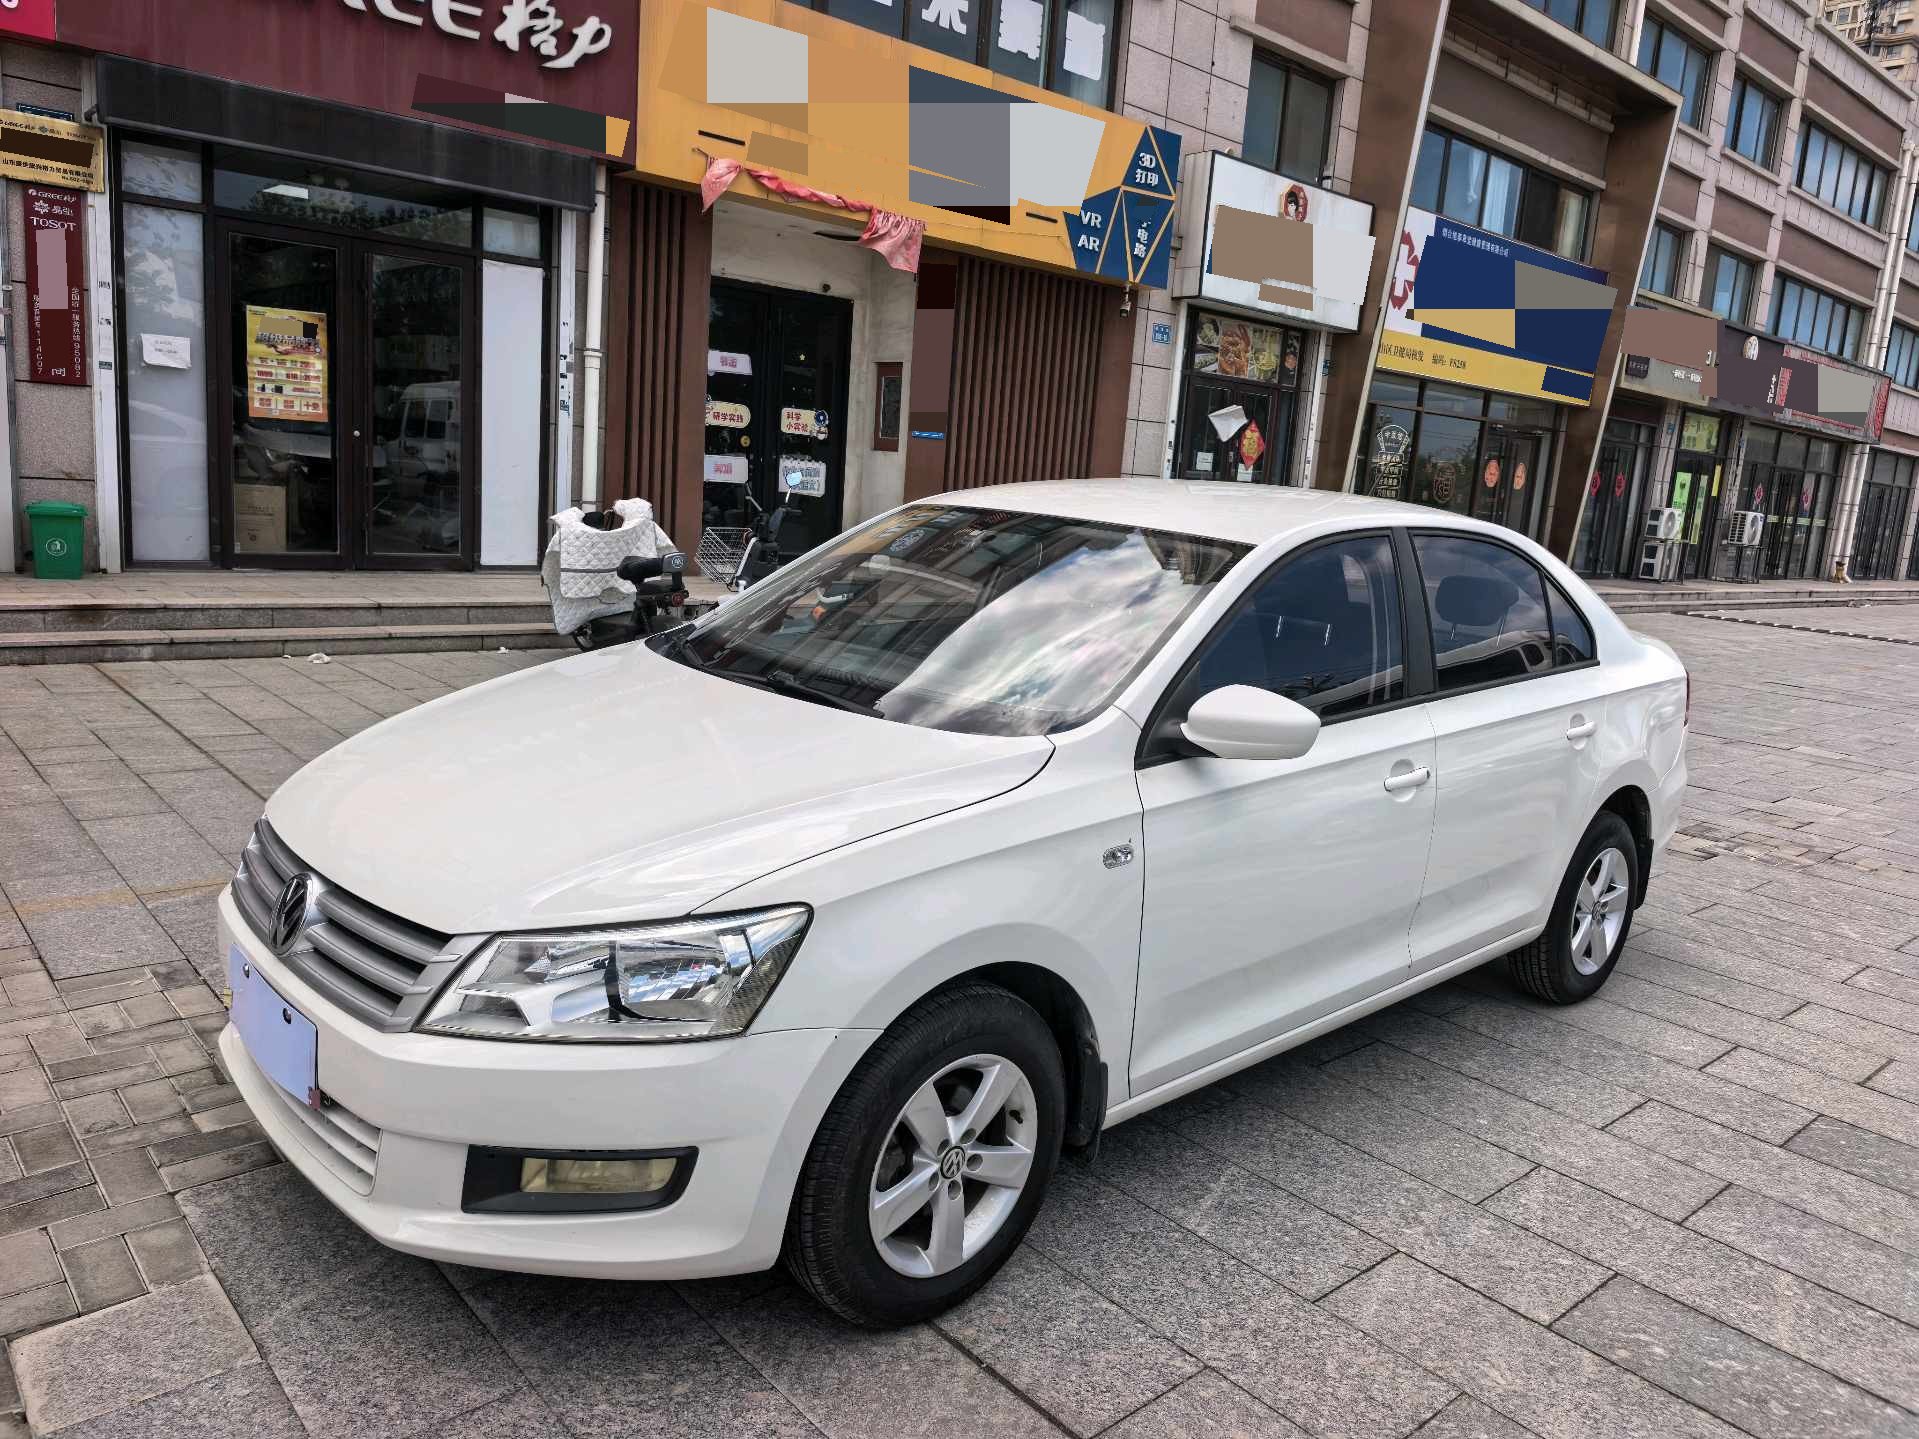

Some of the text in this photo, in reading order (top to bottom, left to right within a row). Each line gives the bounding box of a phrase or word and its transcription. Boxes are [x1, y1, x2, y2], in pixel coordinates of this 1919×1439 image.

[1138, 152, 1156, 168] 3D
[1135, 168, 1159, 187] 打印
[29, 216, 77, 231] TOSOT
[1080, 209, 1102, 229] VR
[1077, 234, 1101, 252] AR
